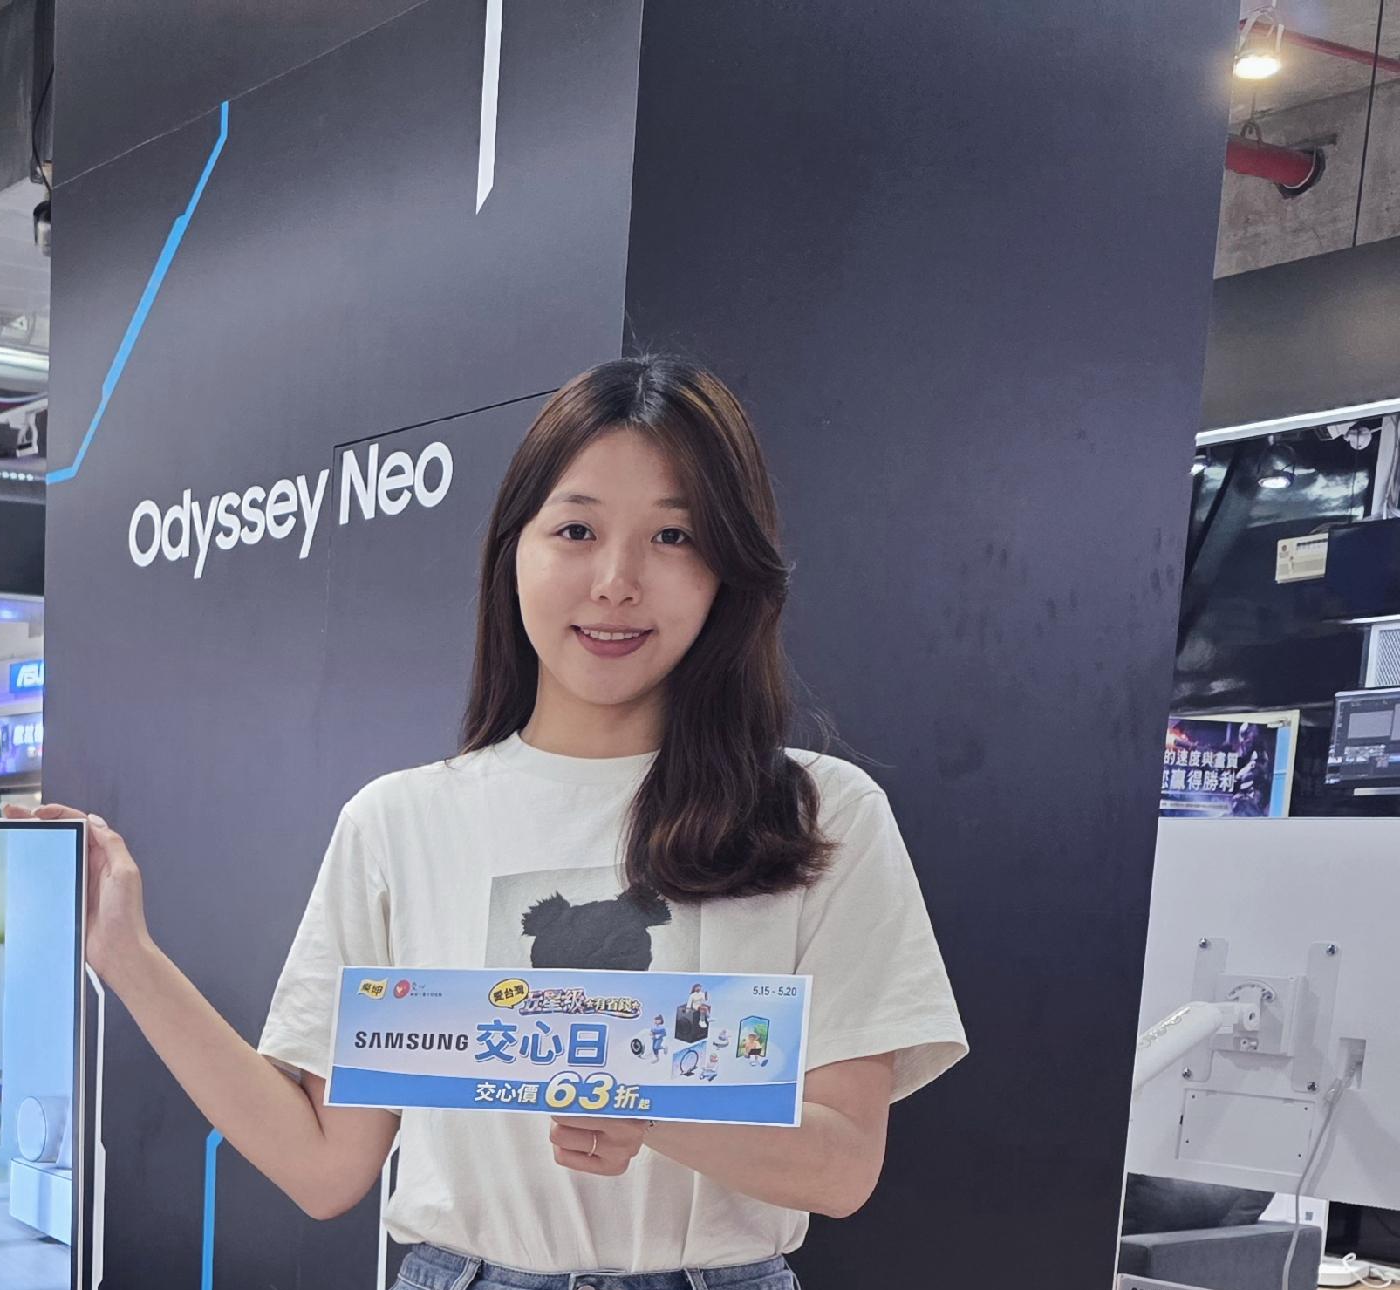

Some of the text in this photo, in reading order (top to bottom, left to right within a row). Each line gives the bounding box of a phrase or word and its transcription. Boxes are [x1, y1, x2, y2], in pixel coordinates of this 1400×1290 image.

[128, 441, 454, 579] Odyssey Neo
[753, 986, 770, 996] 5.15
[778, 986, 797, 997] 5.20
[354, 1018, 609, 1067] SAMSUNG 交心日
